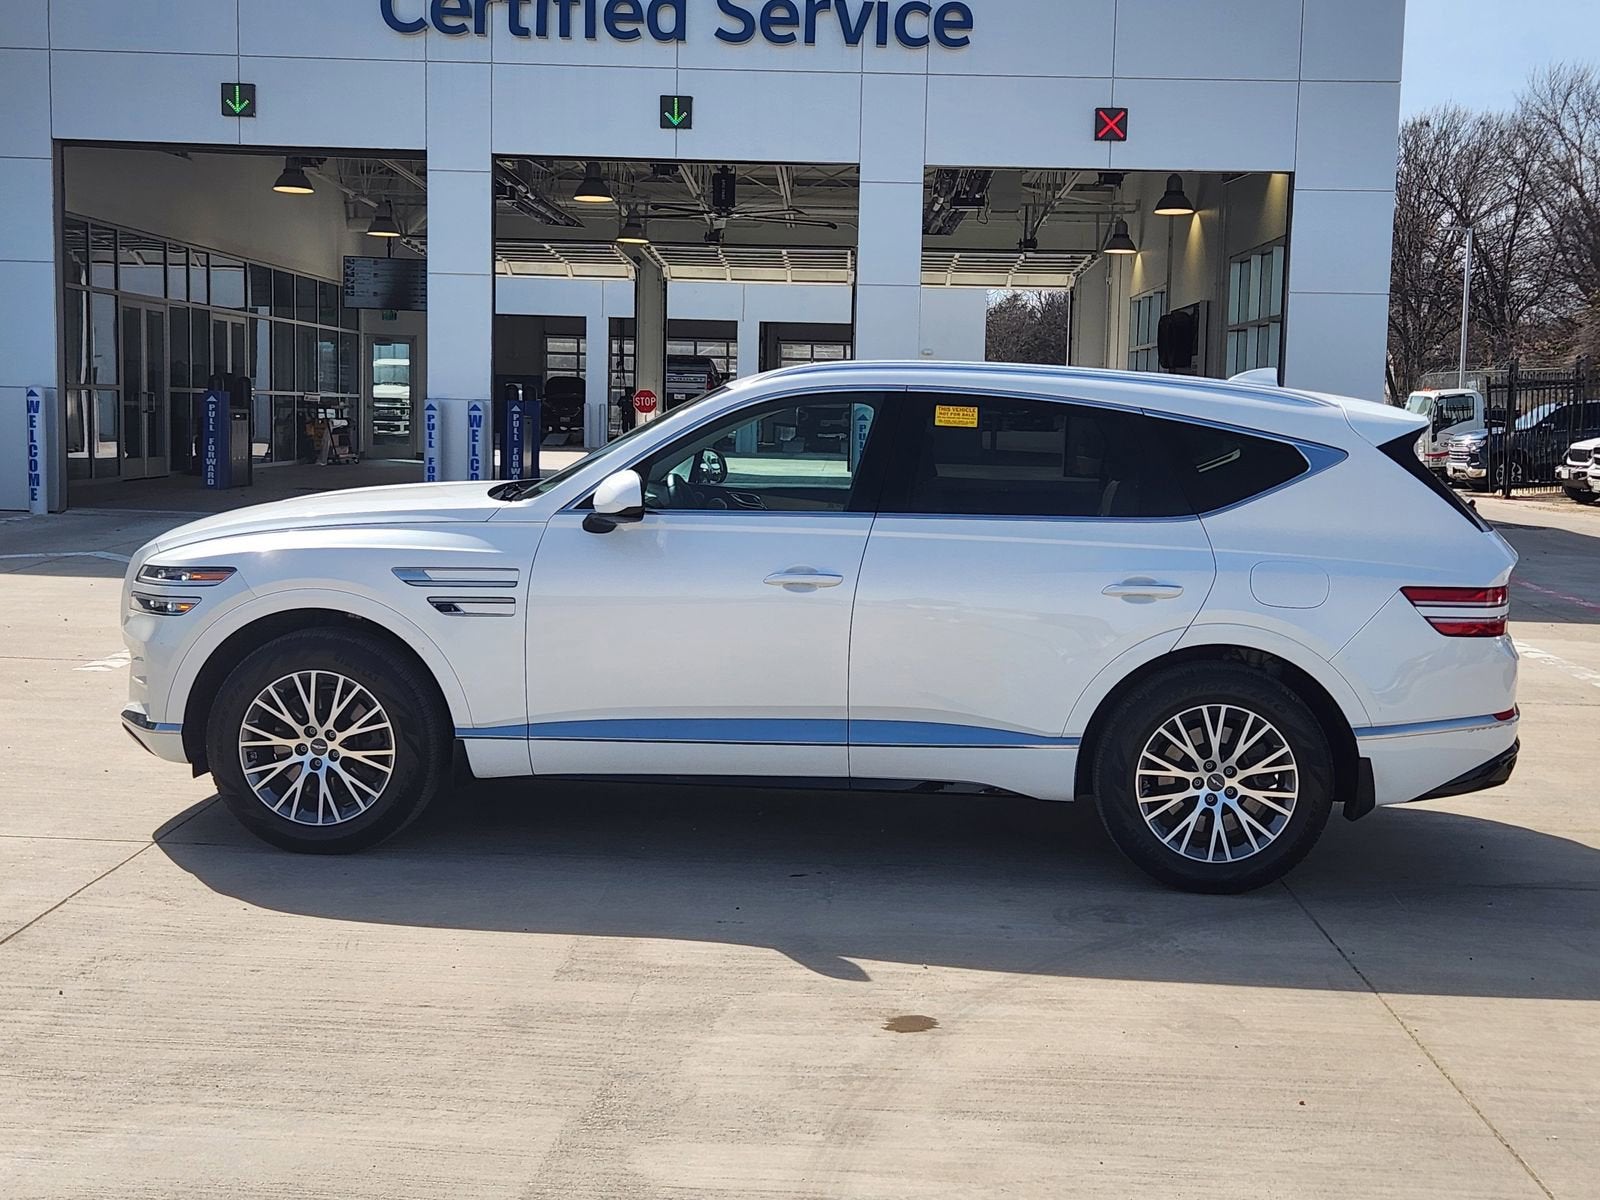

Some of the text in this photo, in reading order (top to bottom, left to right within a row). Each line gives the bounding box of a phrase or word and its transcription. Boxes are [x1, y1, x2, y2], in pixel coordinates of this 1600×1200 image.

[381, 0, 974, 49] Certified Service
[635, 397, 656, 407] STOP
[26, 400, 40, 501] WELCOME
[427, 414, 436, 448] PULL
[469, 415, 482, 481] WELCO
[206, 438, 217, 485] FORWARD
